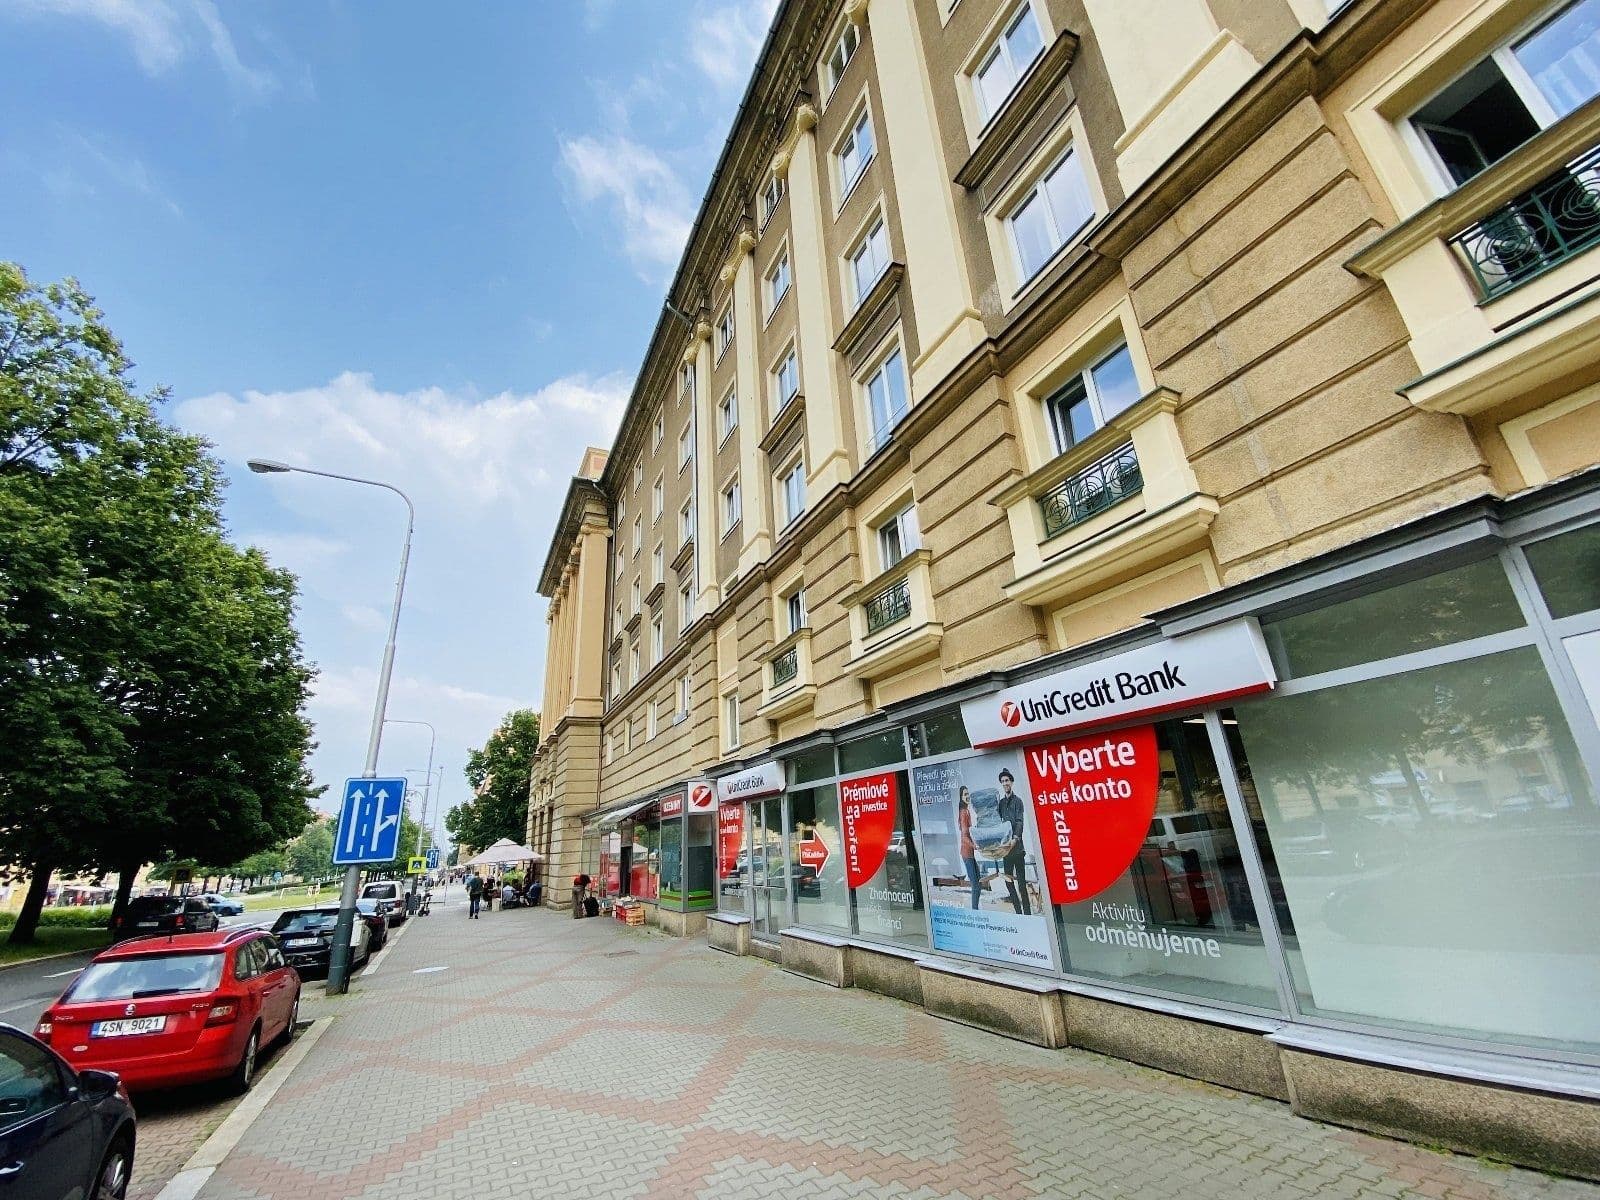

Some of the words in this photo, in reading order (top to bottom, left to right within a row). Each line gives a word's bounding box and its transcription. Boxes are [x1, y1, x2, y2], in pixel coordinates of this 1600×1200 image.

[1020, 678, 1115, 722] UniCredit
[1115, 661, 1187, 701] Bank
[1031, 739, 1136, 783] Vyberte
[842, 778, 889, 803] Prémiové
[1037, 790, 1048, 806] si
[1050, 788, 1069, 805] své
[1069, 777, 1132, 803] konto
[853, 804, 860, 819] a
[861, 801, 888, 813] investice
[845, 805, 861, 874] spoření
[1053, 809, 1079, 891] zdarma
[868, 888, 915, 904] Zhodnocení
[1085, 921, 1222, 958] odměňujeme
[101, 1020, 123, 1033] 4SN
[131, 1017, 160, 1031] 9021
